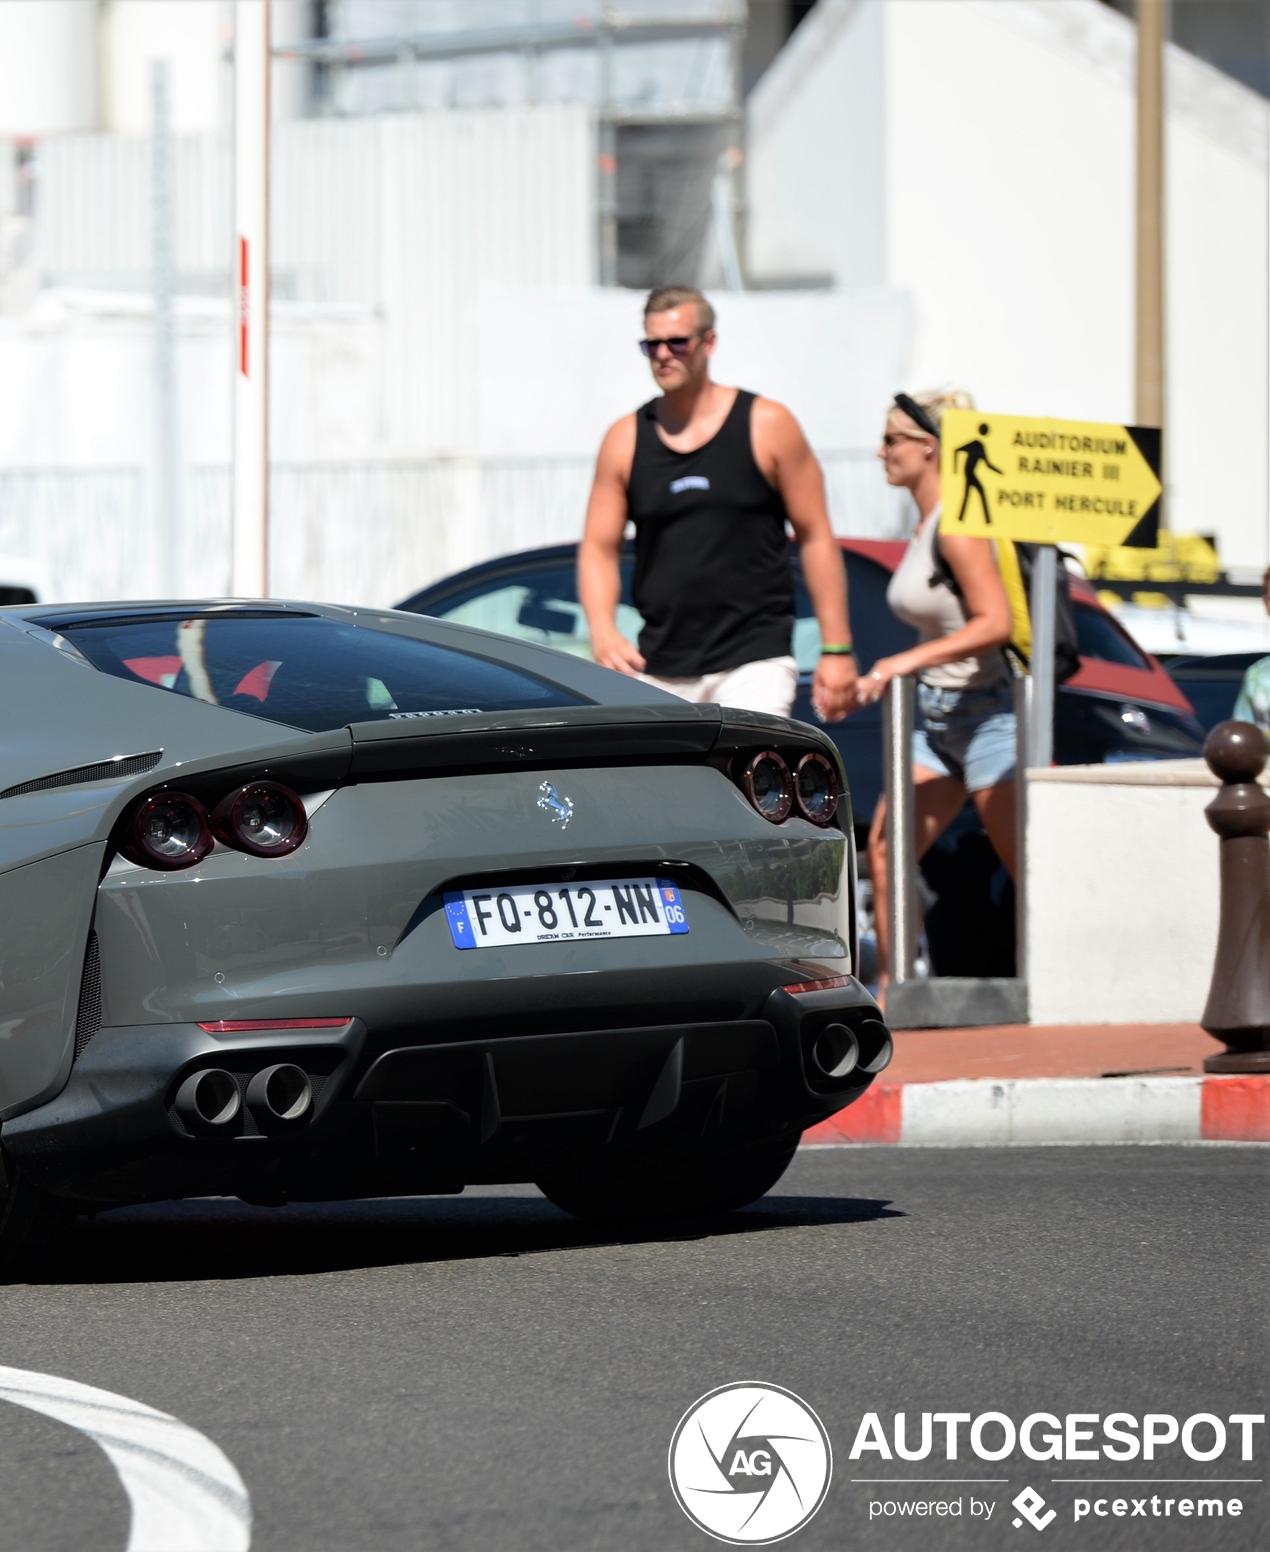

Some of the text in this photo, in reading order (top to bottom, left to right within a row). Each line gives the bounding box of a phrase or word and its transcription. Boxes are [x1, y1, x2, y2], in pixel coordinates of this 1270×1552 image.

[1013, 431, 1128, 455] AUDITORIUM
[1018, 456, 1120, 480] RAINIER III
[997, 489, 1137, 517] PORT HERCULE
[472, 883, 660, 936] FQ-812-NN
[665, 905, 685, 924] 06
[457, 922, 464, 934] F
